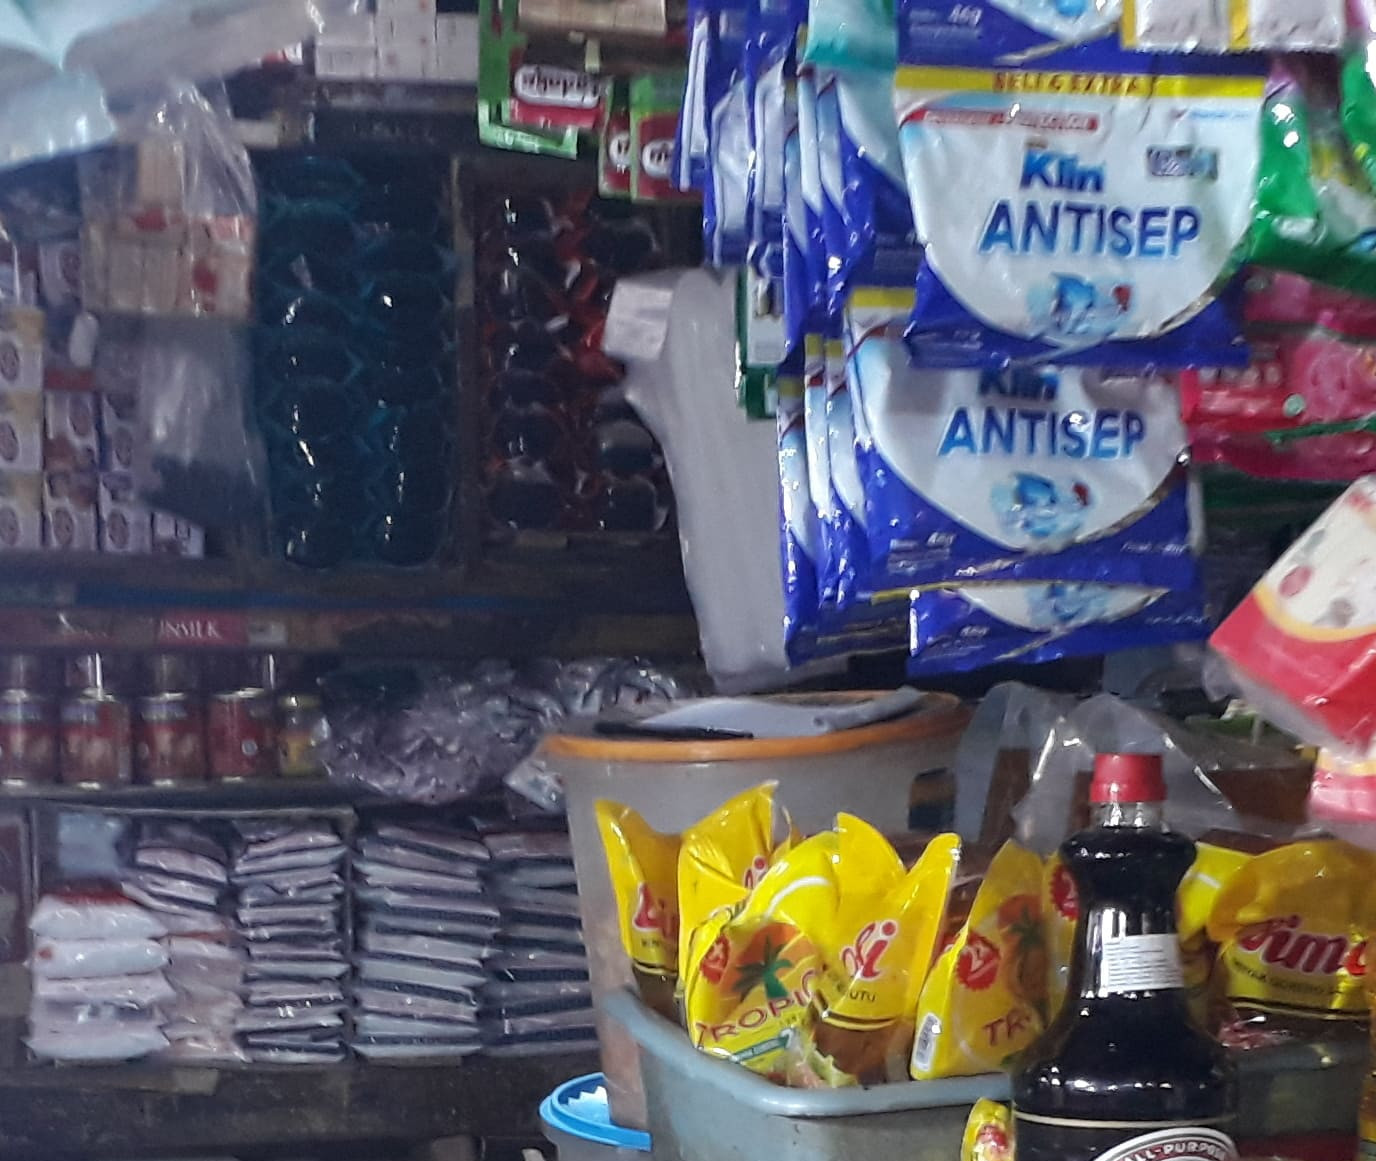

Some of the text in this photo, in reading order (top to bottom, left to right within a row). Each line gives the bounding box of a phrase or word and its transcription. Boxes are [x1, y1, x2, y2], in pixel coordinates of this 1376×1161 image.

[1020, 149, 1106, 193] Klin
[977, 200, 1201, 259] ANTISEP
[937, 407, 1146, 459] ANTISEP
